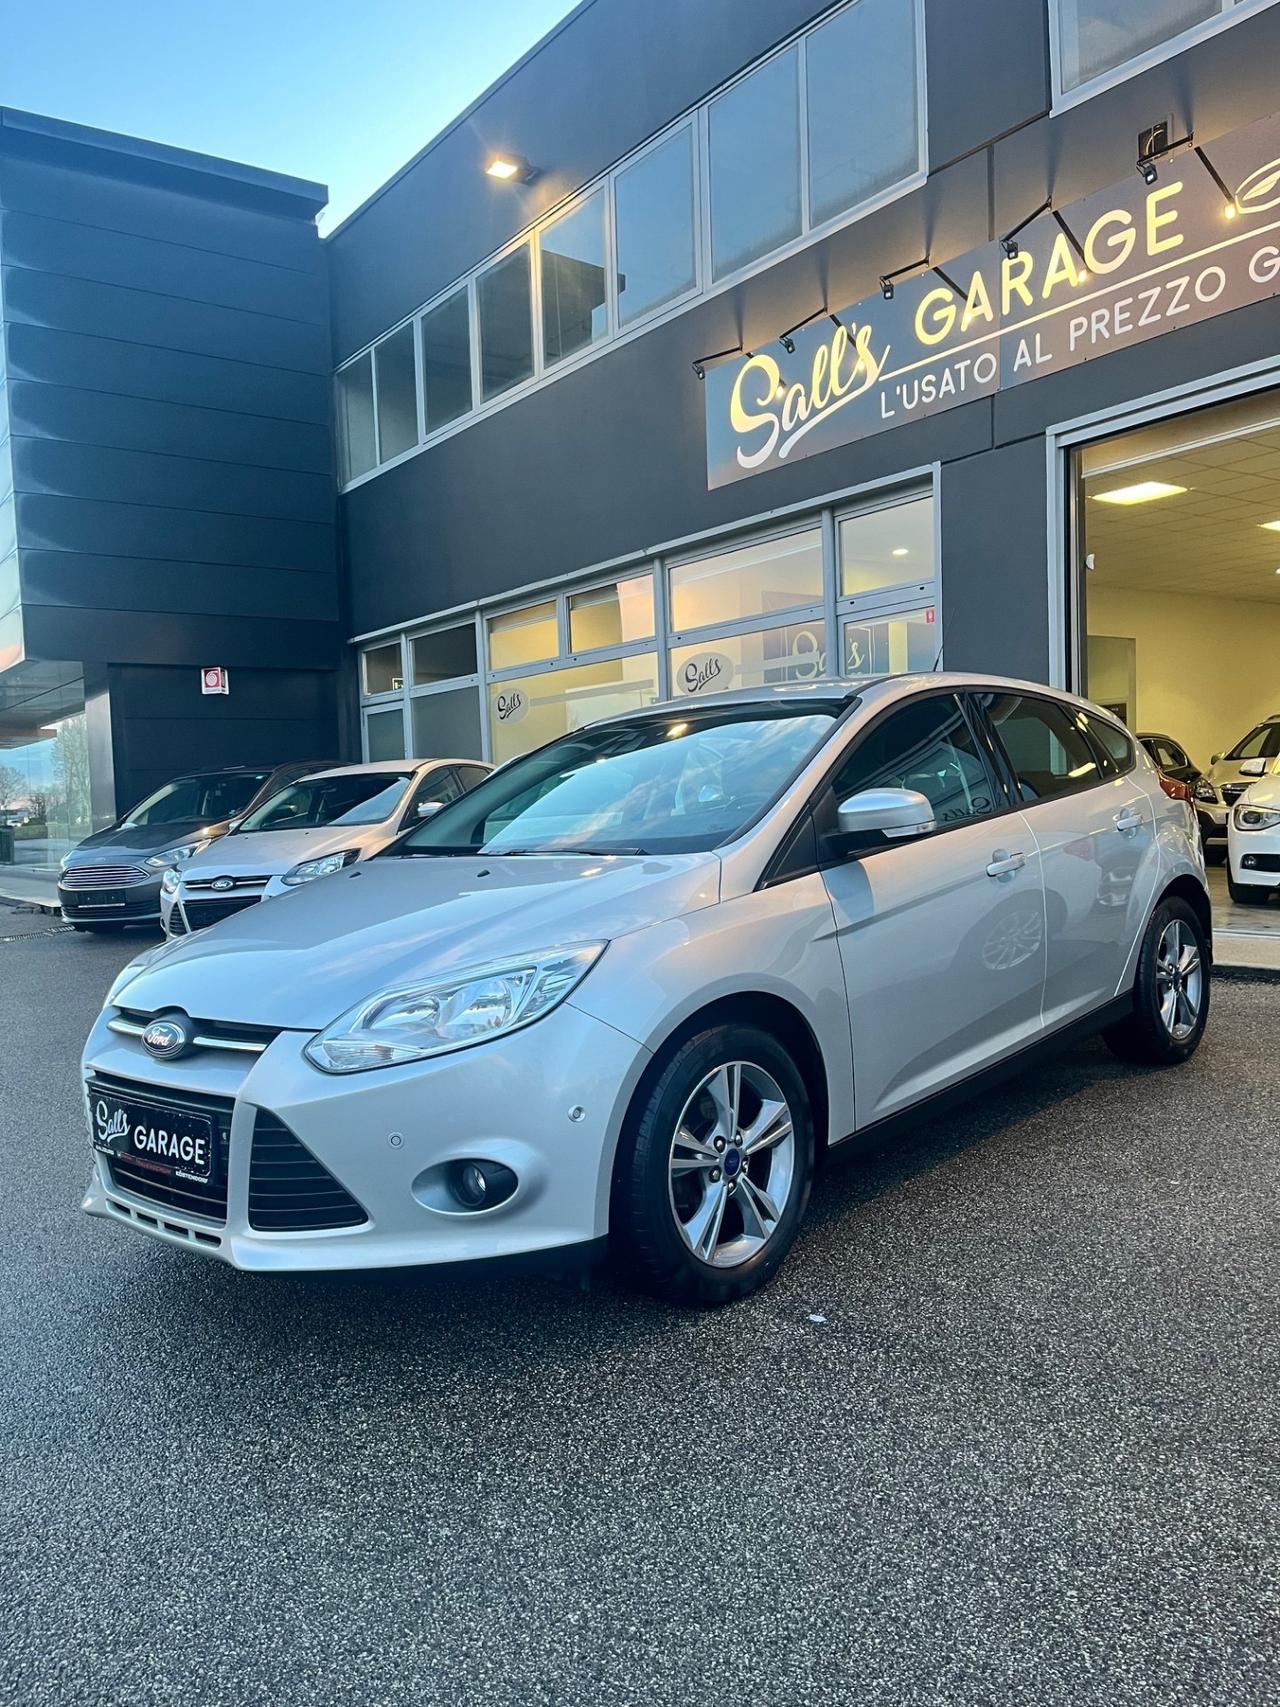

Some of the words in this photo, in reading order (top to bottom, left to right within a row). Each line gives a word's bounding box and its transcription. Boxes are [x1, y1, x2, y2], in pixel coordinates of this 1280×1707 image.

[731, 322, 890, 468] Sall's
[914, 182, 1184, 345] GARAGE
[881, 352, 998, 419] L'USATO
[1013, 333, 1052, 373] AL
[1069, 266, 1226, 351] PREZZO
[147, 1026, 172, 1046] Ford
[134, 1125, 205, 1165] GARAGE
